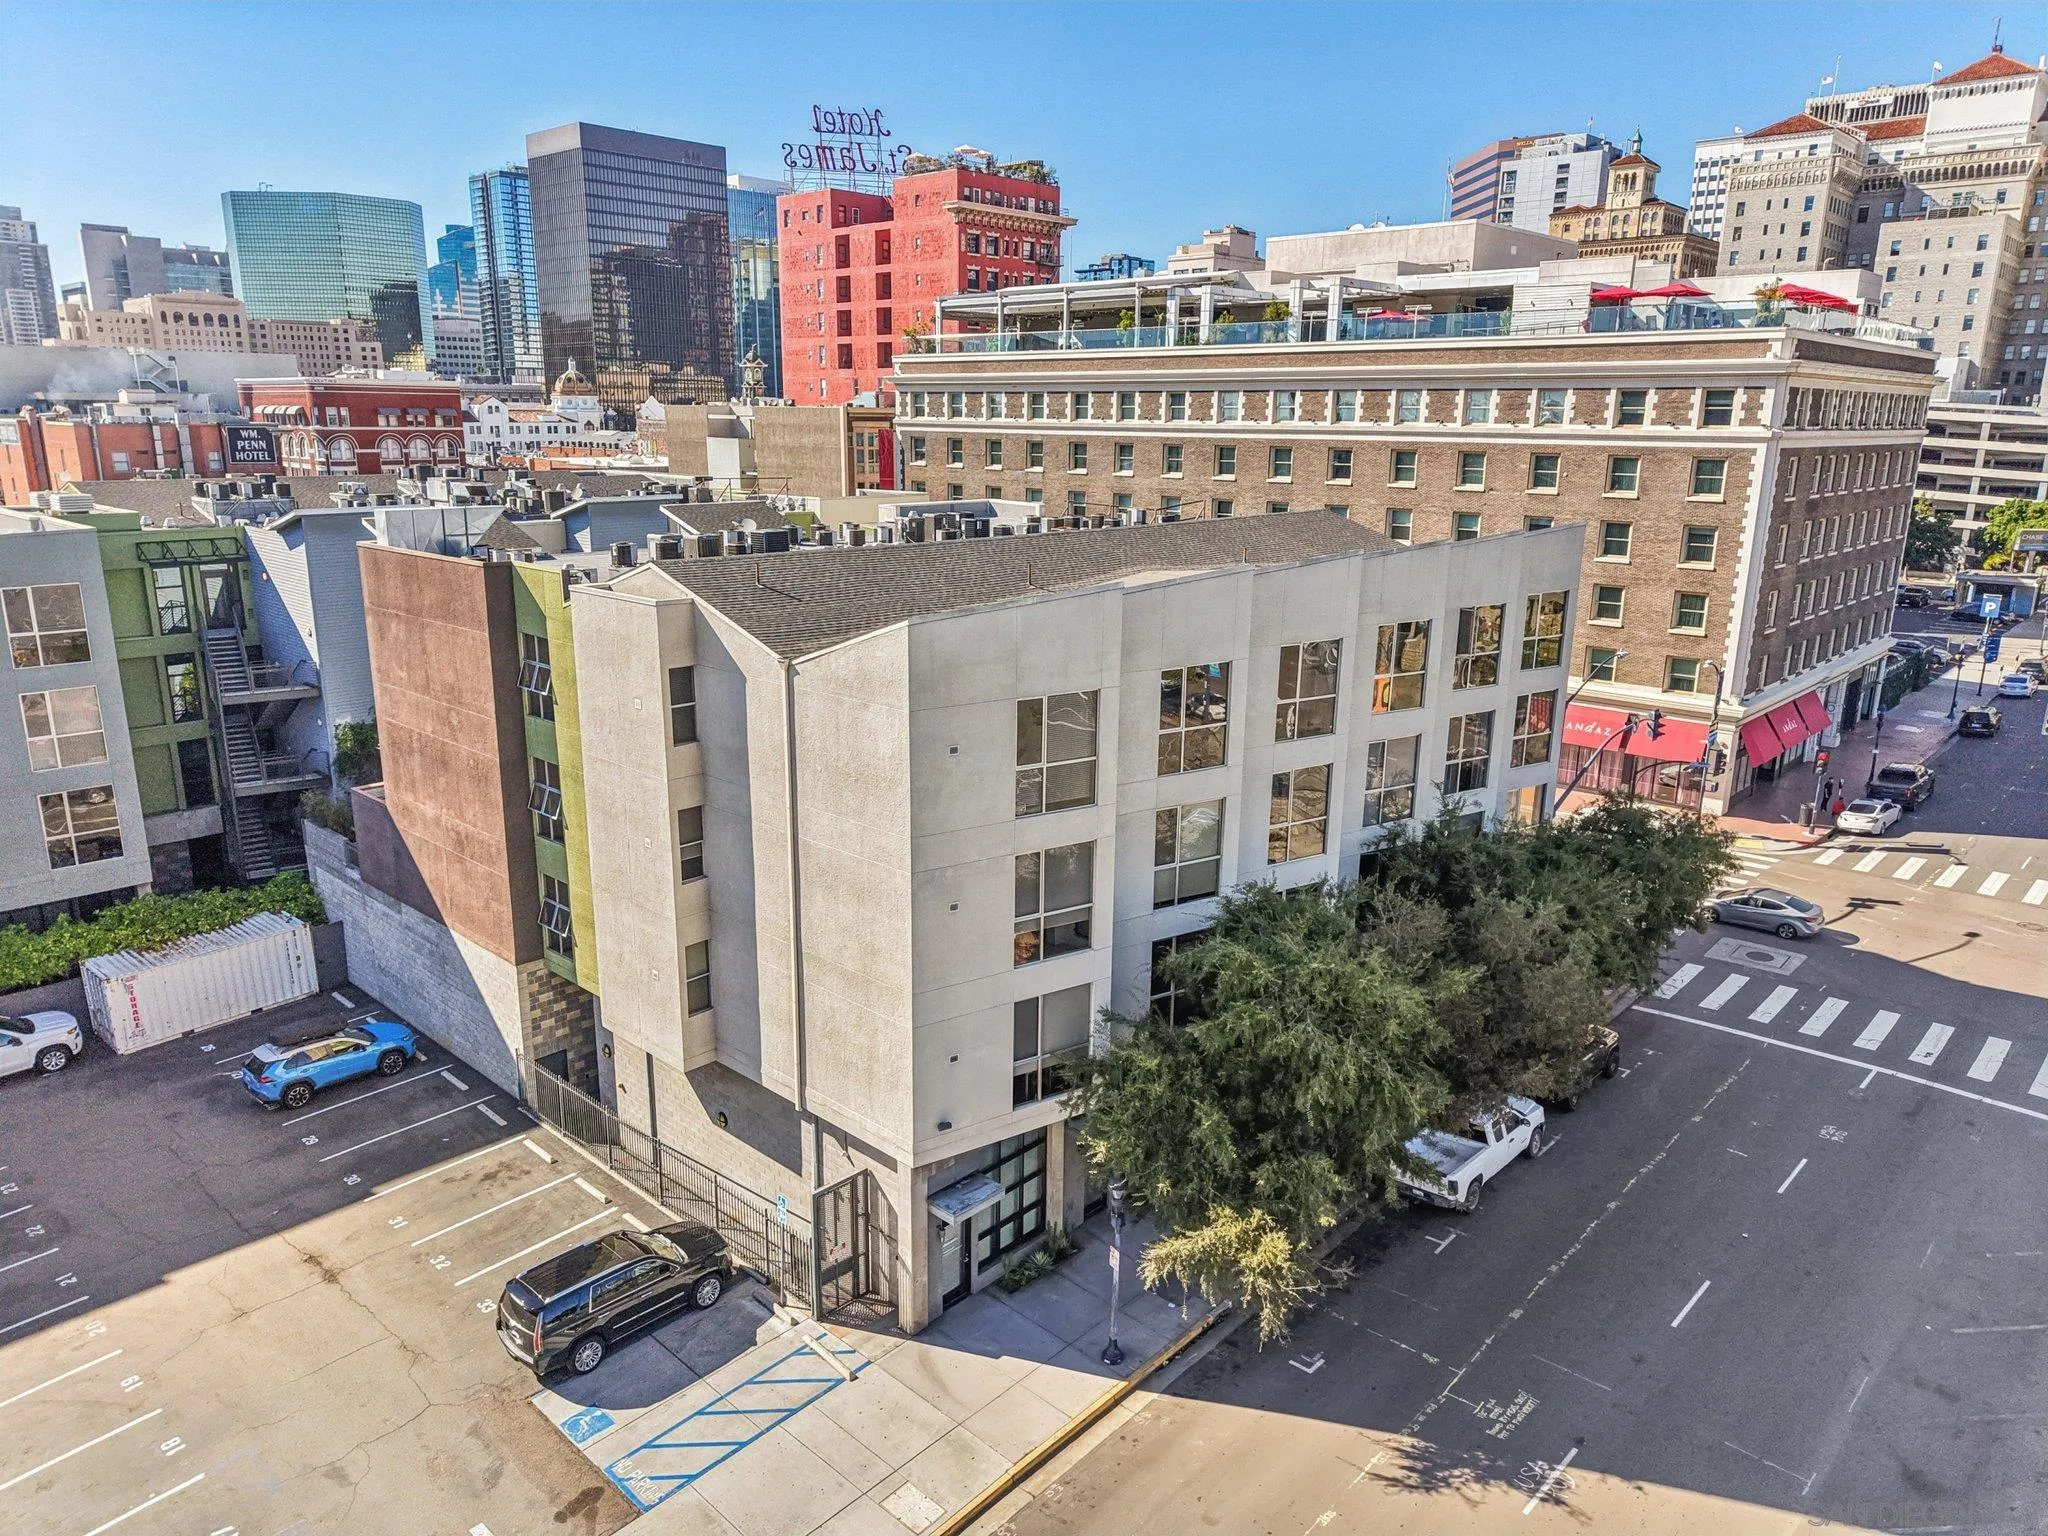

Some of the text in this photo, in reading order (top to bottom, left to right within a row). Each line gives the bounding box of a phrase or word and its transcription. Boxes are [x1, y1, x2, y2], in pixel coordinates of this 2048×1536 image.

[240, 429, 261, 439] WM.
[237, 440, 267, 450] PENN
[235, 451, 271, 461] HOTEL
[301, 1135, 319, 1146] 29
[343, 1174, 362, 1186] 30
[388, 1216, 408, 1229] 31
[429, 1255, 452, 1270] 32
[55, 1273, 77, 1287] 21
[476, 1298, 497, 1313] 33
[120, 1374, 144, 1392] 19
[160, 1436, 186, 1457] 18
